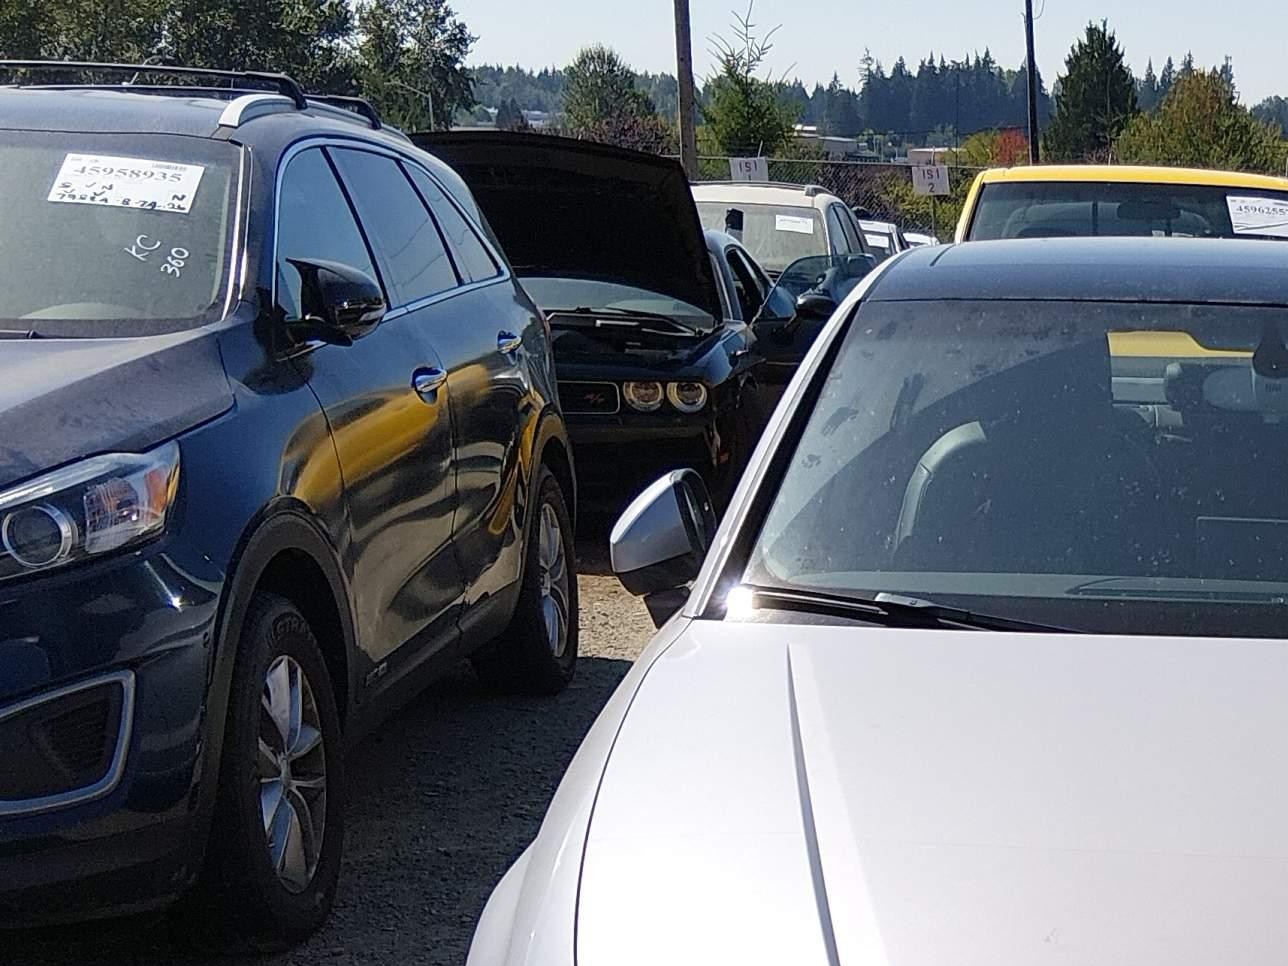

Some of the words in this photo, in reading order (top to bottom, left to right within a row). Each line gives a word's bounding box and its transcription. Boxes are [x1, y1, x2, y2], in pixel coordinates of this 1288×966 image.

[73, 165, 183, 183] 45958935
[927, 182, 936, 193] 2
[123, 233, 162, 262] KC
[160, 246, 189, 278] 360
